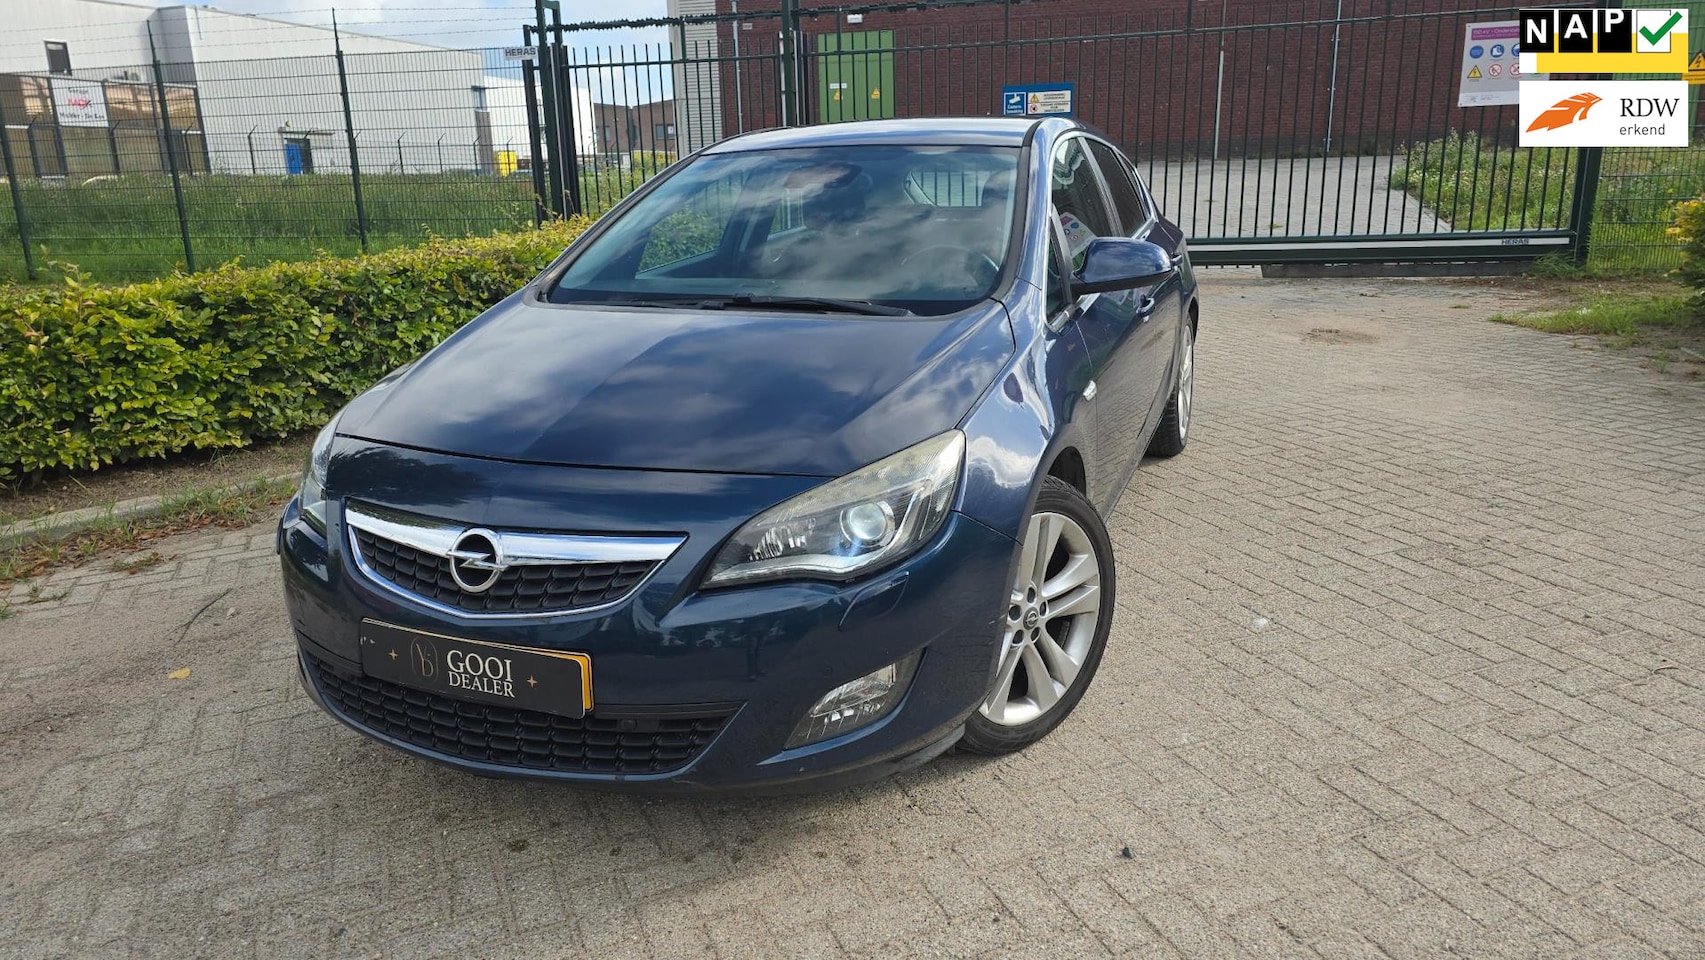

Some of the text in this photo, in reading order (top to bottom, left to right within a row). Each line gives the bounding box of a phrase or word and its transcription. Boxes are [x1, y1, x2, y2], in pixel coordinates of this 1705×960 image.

[505, 47, 537, 57] HERAS
[446, 649, 514, 682] GOOI
[448, 671, 516, 698] DEALER
